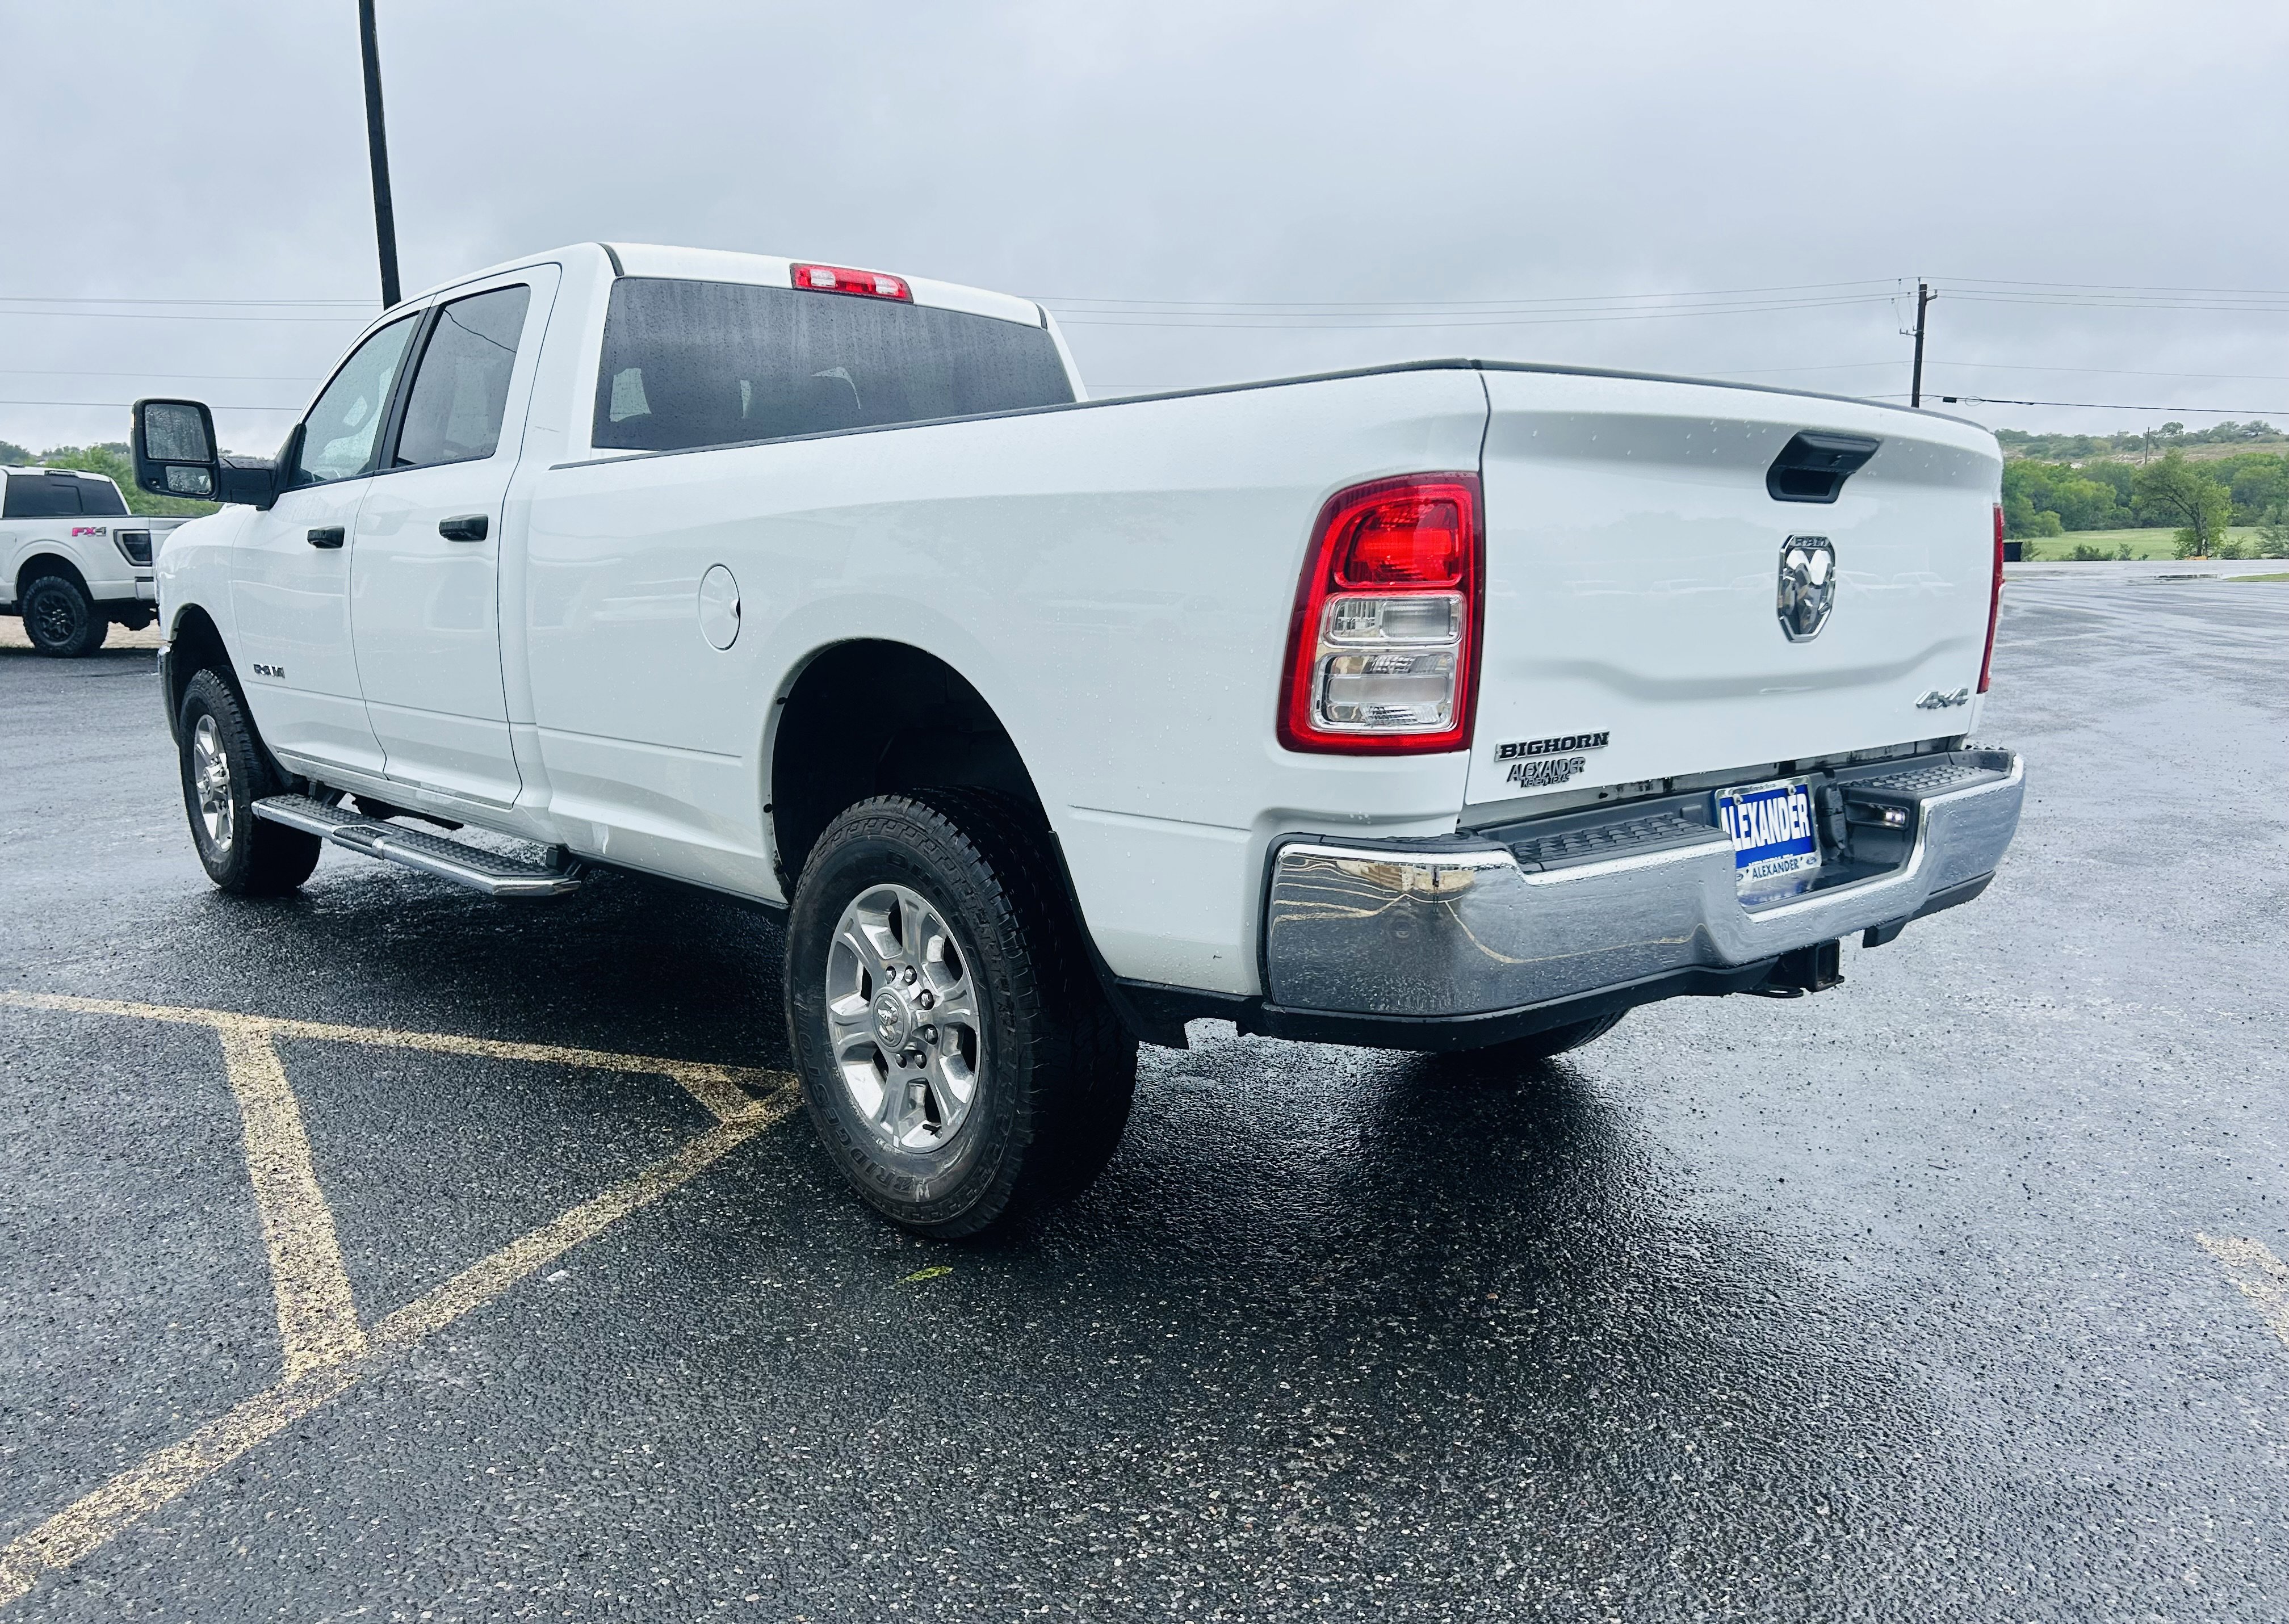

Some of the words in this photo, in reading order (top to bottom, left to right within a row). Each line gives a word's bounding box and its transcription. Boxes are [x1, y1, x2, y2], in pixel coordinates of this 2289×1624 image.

[72, 527, 107, 537] FX4
[1795, 536, 1827, 547] RAM
[253, 663, 286, 679] RAM
[1499, 731, 1610, 759] BIGHORN
[1506, 756, 1586, 782] ALEXANDER
[1721, 793, 1811, 853] ALEXANDER
[1752, 858, 1800, 879] ALEXANDER
